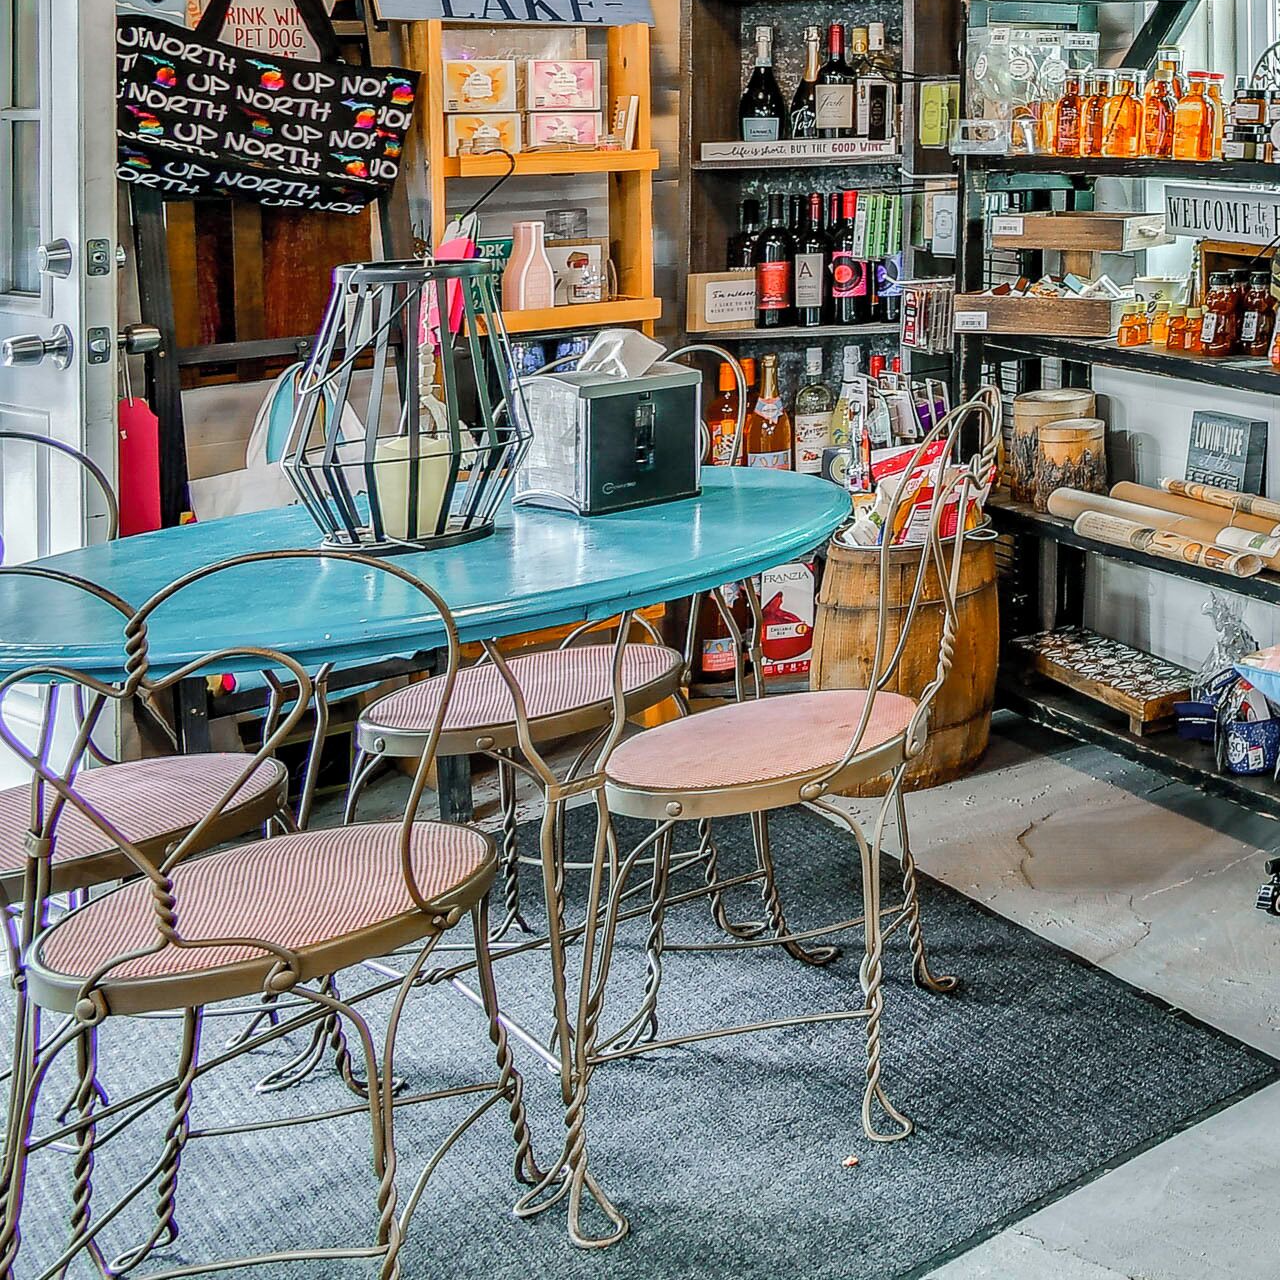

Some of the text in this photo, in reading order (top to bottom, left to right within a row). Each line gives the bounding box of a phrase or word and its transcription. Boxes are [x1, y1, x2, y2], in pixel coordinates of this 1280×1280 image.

[142, 31, 236, 74] NORTH
[235, 28, 306, 48] PET DOG.
[187, 72, 230, 96] UP
[236, 85, 331, 121] NORTH
[292, 72, 335, 95] UP
[128, 82, 228, 122] NORTH
[173, 122, 218, 145] UP
[223, 131, 321, 170] NORTH
[281, 123, 323, 145] UP
[790, 143, 856, 154] BUY THE GOOD
[164, 162, 320, 199] UP NORTH
[1167, 197, 1250, 234] WELCOME
[1223, 426, 1244, 457] LIFE
[763, 571, 809, 584] FRANZIA
